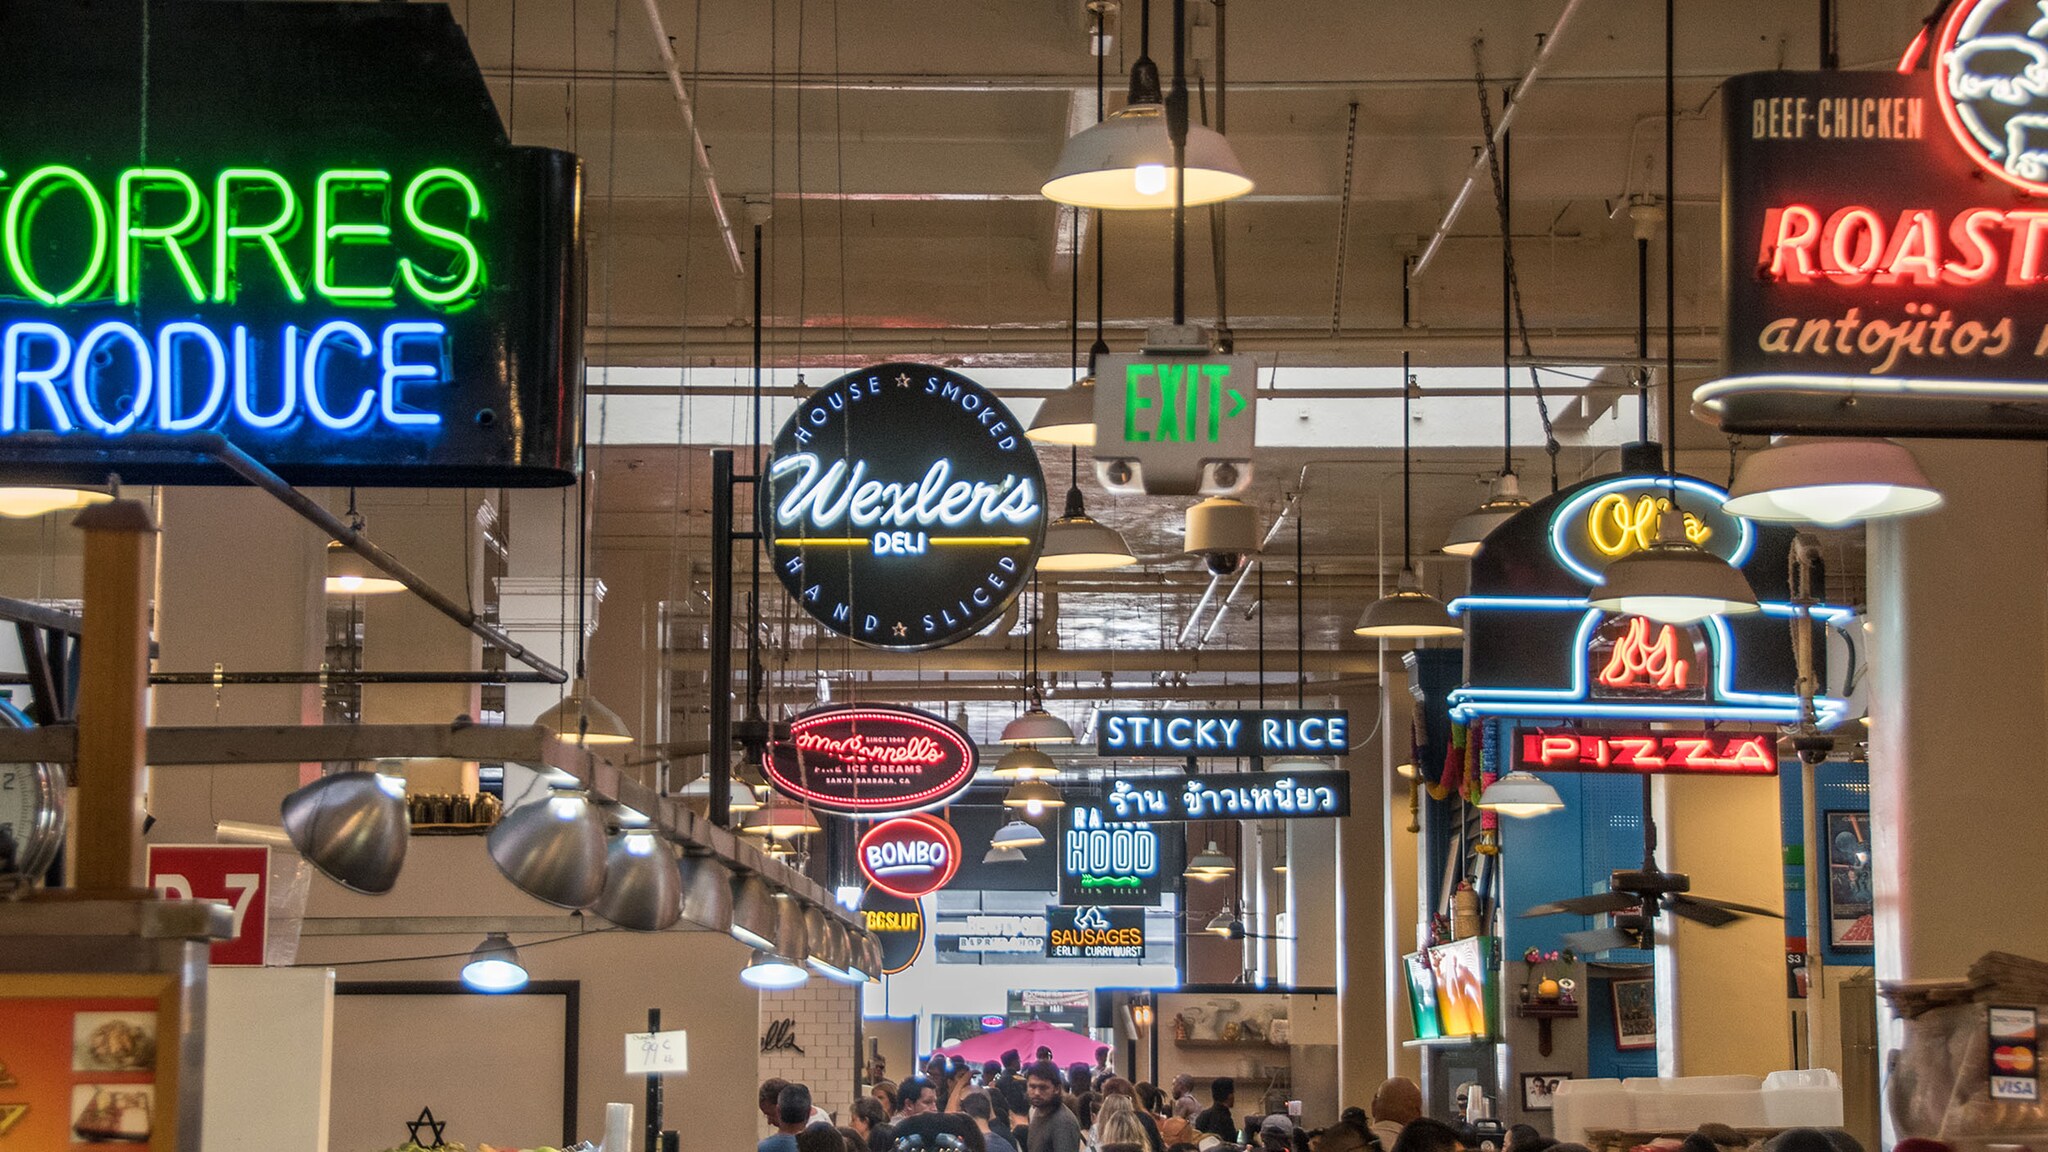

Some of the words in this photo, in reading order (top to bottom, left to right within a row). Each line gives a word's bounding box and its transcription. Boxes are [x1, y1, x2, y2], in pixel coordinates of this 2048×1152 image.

[0, 165, 487, 306] ORRES
[793, 375, 881, 444] HOUSE
[925, 376, 1018, 452] SMOKED
[1124, 363, 1231, 443] EXIT
[769, 452, 1041, 529] Wexler's
[873, 531, 926, 555] DELI
[785, 555, 878, 632] HAND
[923, 555, 1016, 632] SLICED
[1108, 716, 1242, 748] STICKY
[1262, 717, 1347, 748] RICE
[847, 764, 867, 773] ICE
[872, 764, 923, 774] CREAMS
[1524, 736, 1776, 772] PIZZA
[1108, 780, 1166, 815] ร้าน
[1183, 777, 1336, 815] ข้าวเหนียว
[866, 841, 946, 871] BOMBO
[1067, 829, 1158, 876] HOOD
[1051, 928, 1142, 946] SAUSAGES
[1085, 945, 1141, 957] CURRYWURST
[1998, 1081, 2033, 1095] VISA
